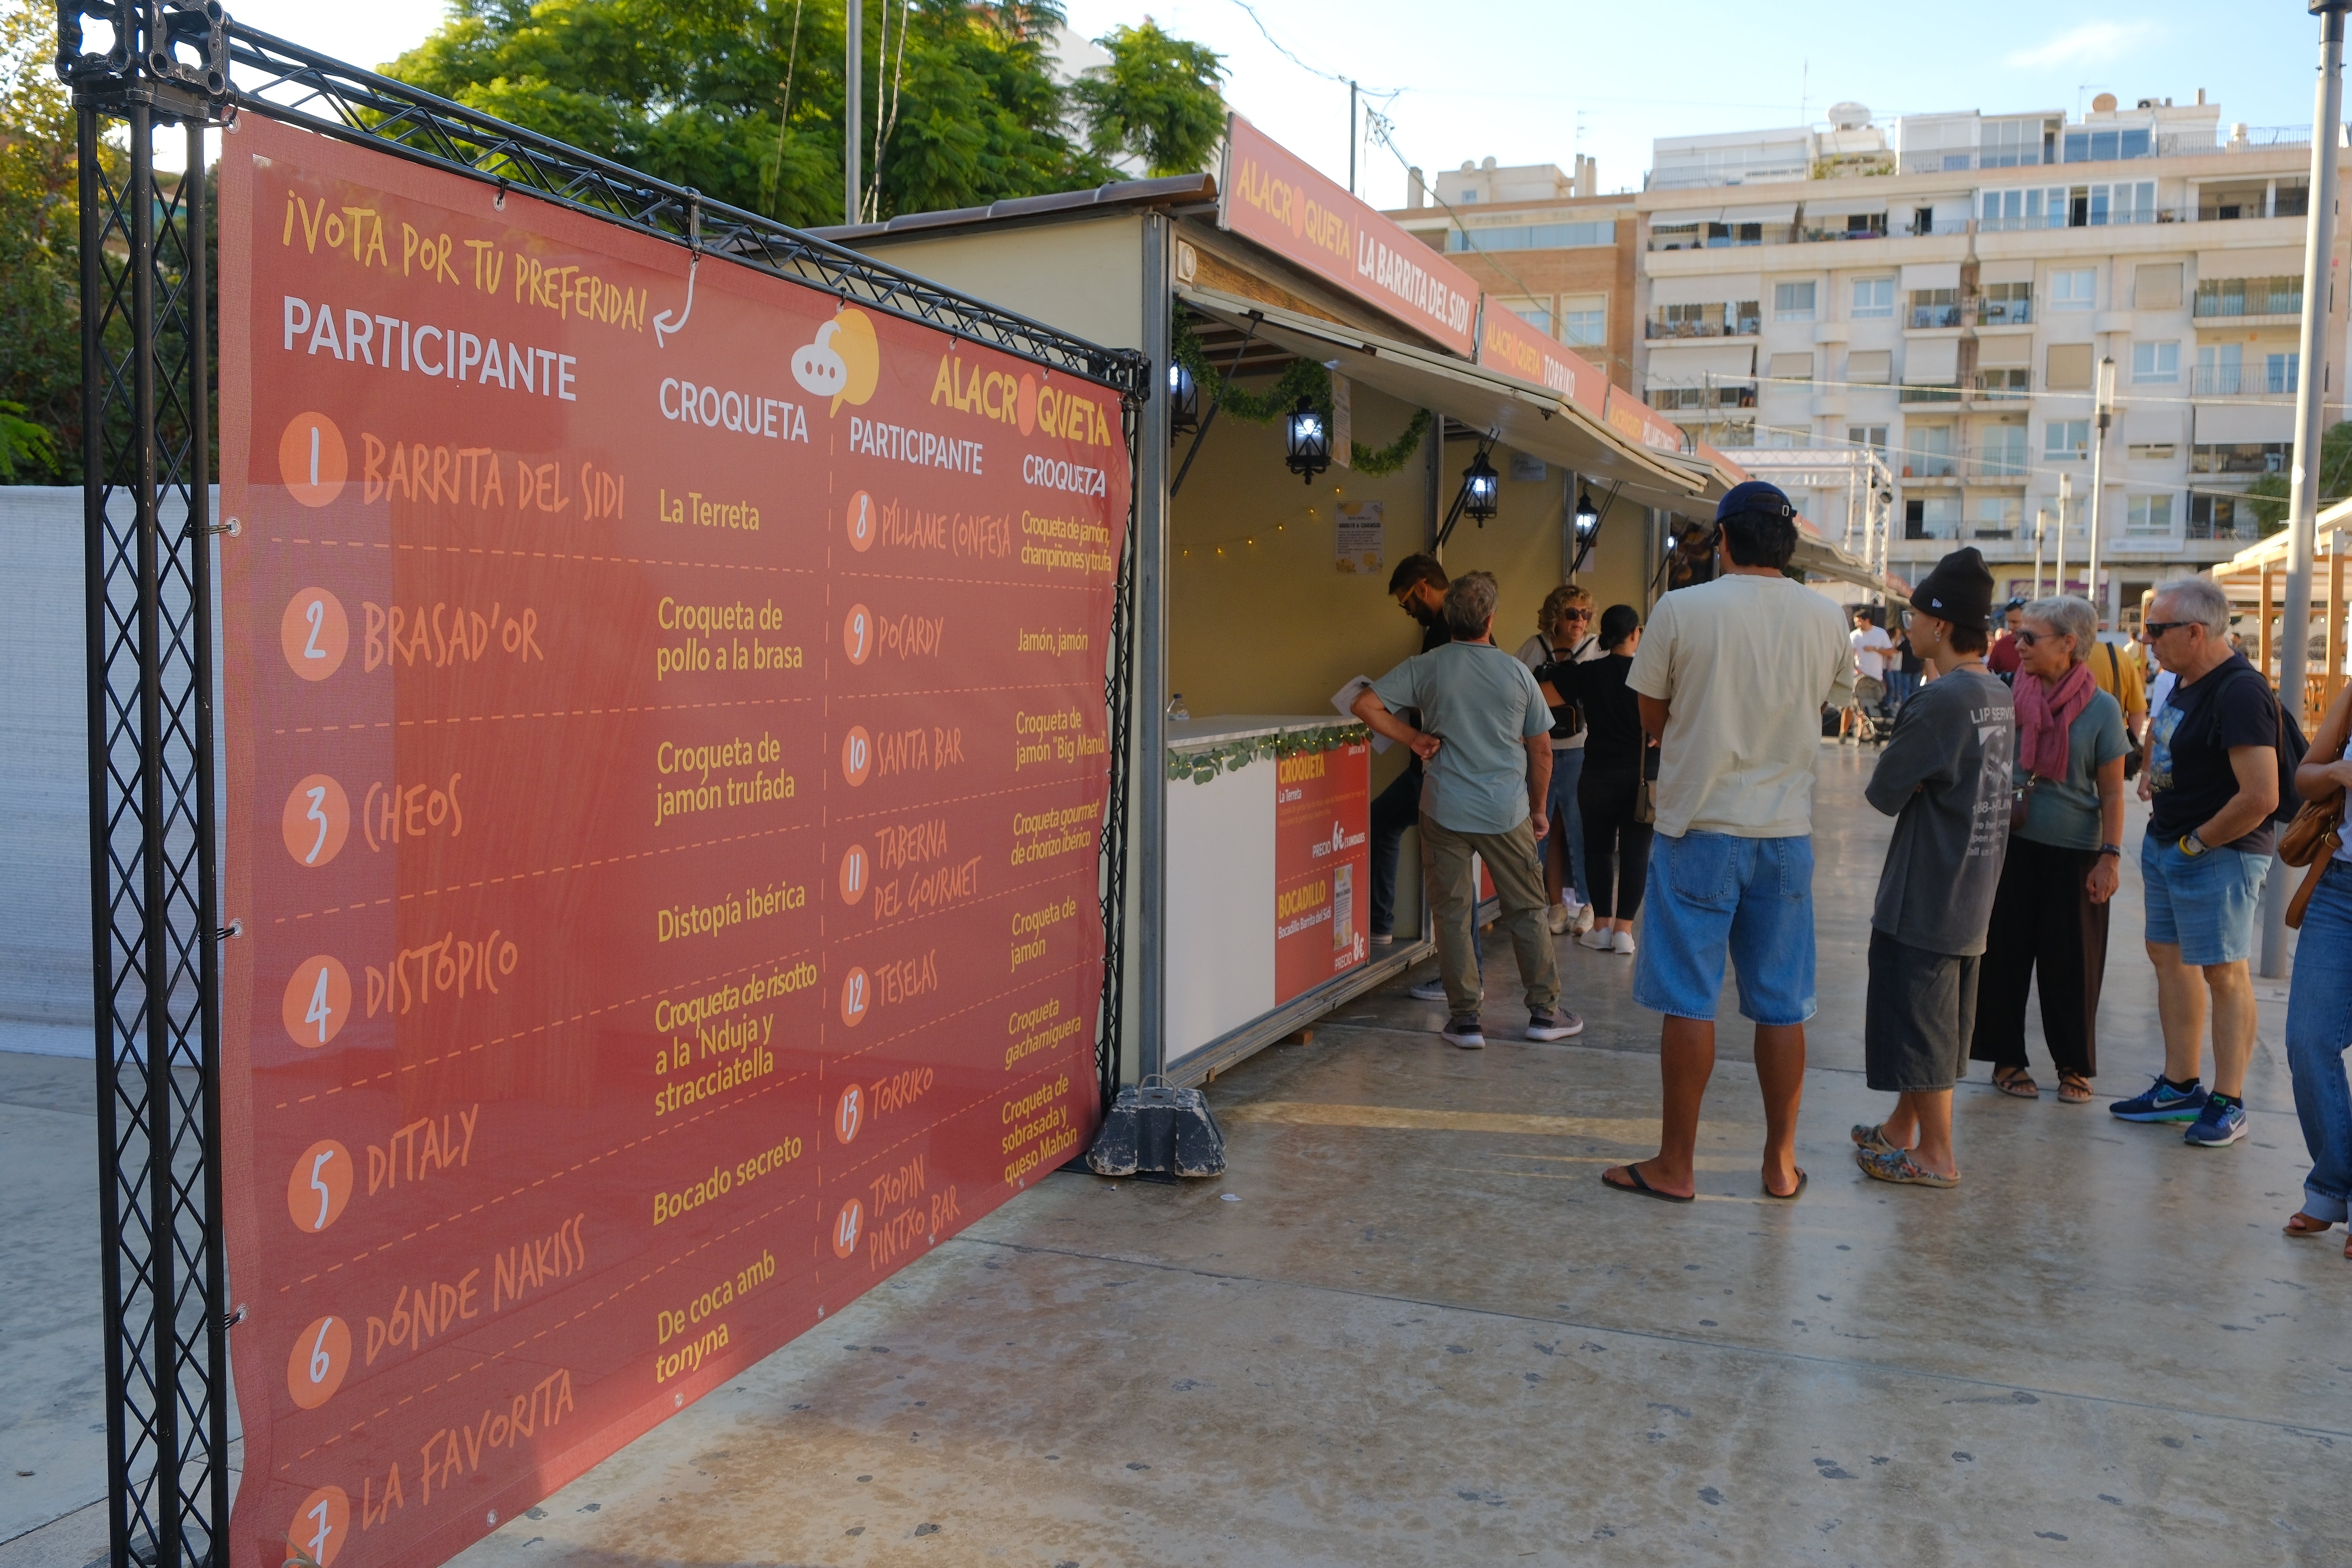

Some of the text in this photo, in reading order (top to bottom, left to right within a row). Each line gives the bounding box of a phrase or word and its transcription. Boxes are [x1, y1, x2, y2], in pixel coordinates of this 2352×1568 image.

[283, 190, 646, 332] ¡VOTA POR TU PREFERIDA!
[1358, 230, 1470, 336] LA BARRITA DEL SIDI
[285, 295, 576, 401] PARTICIPANTE
[1544, 354, 1575, 398] TORRIKO
[659, 378, 808, 443] CROQUETA
[850, 416, 983, 475] PARTICIPANTE
[310, 427, 624, 521] 1 BARRITA DEL SIDI
[1023, 455, 1106, 498] CROQUETA
[660, 489, 760, 530] La Terreta
[856, 495, 1011, 560] 8 PÍLLAME CONFESA
[1022, 510, 1110, 547] Croqueta de jamón,
[1021, 540, 1111, 575] champiñones y trufa
[304, 601, 543, 672] 2 BRASAD'OR
[658, 597, 782, 638] Croqueta de
[854, 613, 943, 660] 9 POCARDY
[1018, 627, 1088, 657] Jamón, jamón
[657, 638, 802, 681] pollo a la brasa
[1016, 706, 1081, 738] Croqueta de
[1970, 707, 1990, 724] LIP
[657, 731, 780, 778] Croqueta de
[850, 726, 964, 777] 10 SANTA BAR
[1015, 730, 1105, 771] jamón "Big Manu"
[1280, 754, 1325, 784] CROQUETA
[306, 773, 461, 864] 3 CHEOS
[655, 768, 794, 826] jamón trufada
[1013, 799, 1099, 837] Croqueta gourmet
[1279, 791, 1285, 803] La
[1285, 788, 1302, 801] Terreta
[875, 819, 947, 870] TABERNA
[1011, 827, 1091, 866] de chorizo ibérico
[1312, 841, 1331, 858] PRECIO
[1333, 821, 1344, 851] 6€
[849, 853, 860, 891] 11
[874, 855, 982, 921] DEL GOURMET
[658, 881, 805, 942] Distopía ibérica
[1012, 896, 1076, 940] Croqueta de
[1279, 880, 1326, 919] BOCADILLO
[1279, 920, 1300, 939] Bocadillo
[1300, 913, 1315, 930] Barrita
[1335, 932, 1364, 971] PRECIO 8€
[1011, 936, 1046, 973] jamón
[305, 930, 517, 1042] 4 DISTÓPICO
[655, 961, 817, 1033] Croqueta de risotto
[848, 949, 937, 1014] 12 TESELAS
[1009, 998, 1059, 1035] Croqueta
[655, 1051, 667, 1075] a
[674, 1036, 690, 1069] la
[763, 1013, 773, 1045] y
[1005, 1016, 1081, 1071] gachamiguera
[655, 1046, 773, 1116] stracciatella
[842, 1067, 933, 1140] 13 TORRIKO
[1002, 1073, 1069, 1124] Croqueta de
[1001, 1105, 1067, 1155] sobrasada y
[311, 1103, 479, 1228] 5 DITALY
[654, 1136, 801, 1226] Bocado secreto
[1005, 1125, 1077, 1187] queso Mahón
[870, 1154, 925, 1218] TXOPIN
[840, 1205, 857, 1253] 14
[869, 1185, 960, 1272] PINTXO BAR
[310, 1214, 584, 1383] 6 DÓNDE NAKISS
[658, 1249, 775, 1344] De coca amb
[655, 1323, 729, 1384] tonyna
[308, 1368, 573, 1566] 7 LA FAVORITA
